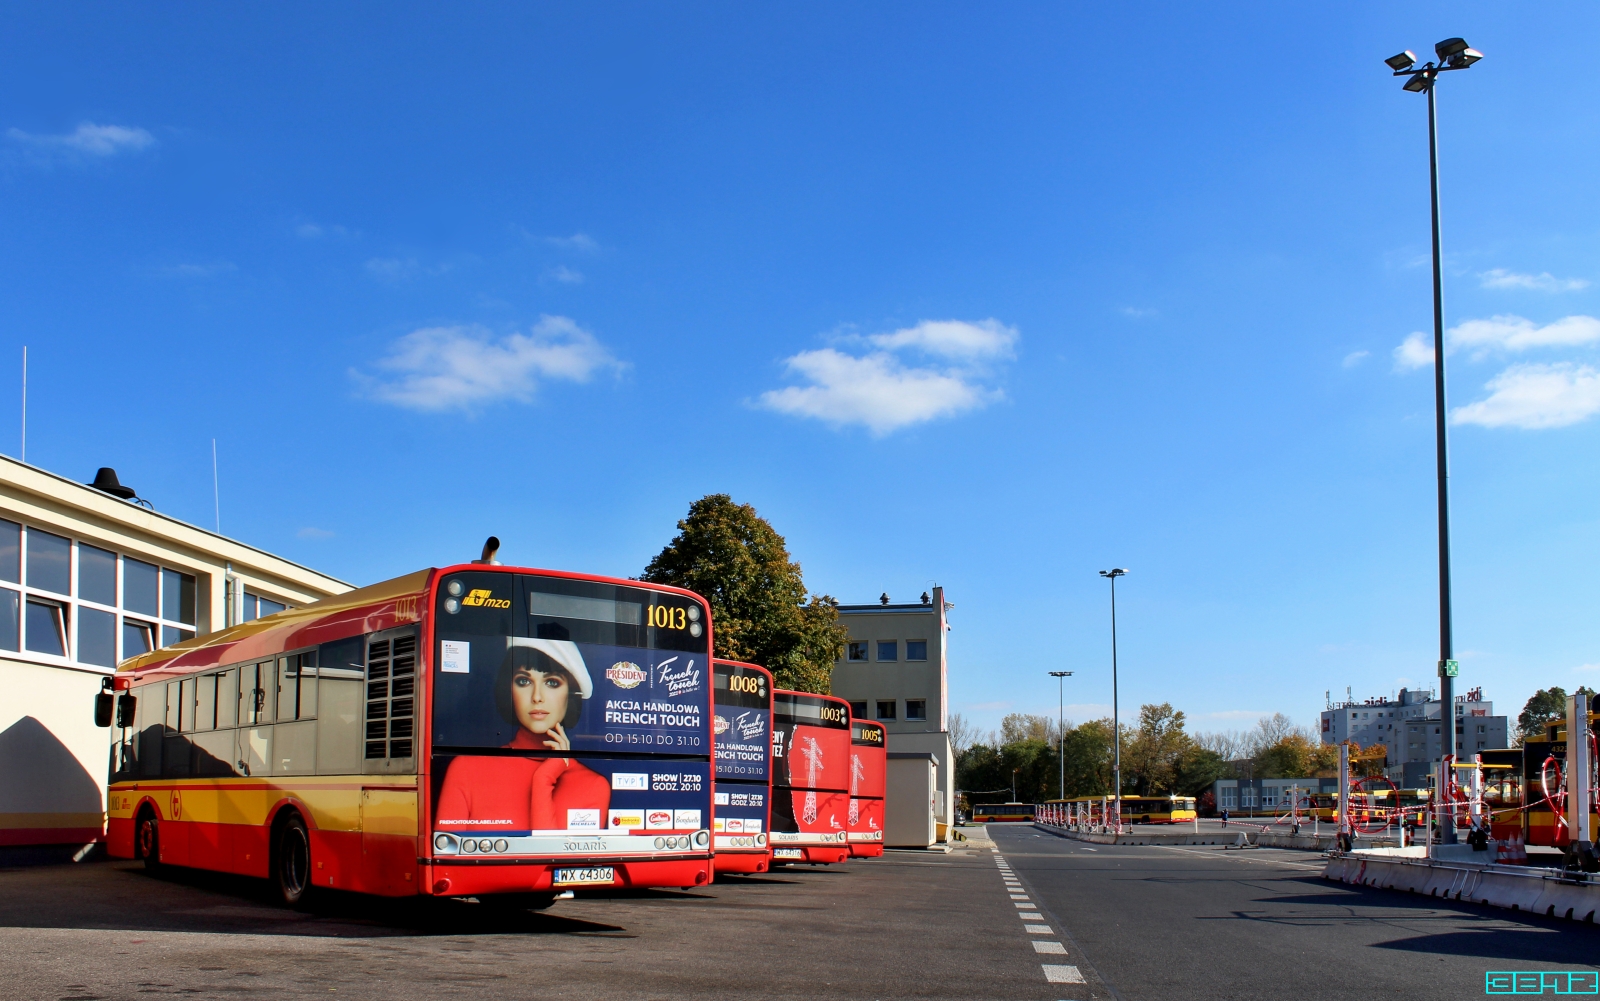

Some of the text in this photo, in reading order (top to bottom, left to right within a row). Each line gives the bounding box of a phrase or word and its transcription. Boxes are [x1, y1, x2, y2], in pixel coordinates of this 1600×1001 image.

[395, 596, 417, 622] 1013
[647, 604, 686, 630] 1013
[606, 668, 647, 681] PRÉSIDENT
[656, 655, 695, 684] French
[665, 669, 700, 692] touch
[729, 675, 758, 693] 1008
[606, 700, 700, 714] AKCJA HANDLOWA
[605, 711, 700, 727] FRENCH TOUCH
[820, 707, 840, 722] 1003
[605, 733, 700, 747] OD 15.10 DO 31.10
[861, 729, 878, 741] 1005
[726, 744, 764, 752] HANDLOWA
[737, 752, 764, 761] TOUCH
[735, 766, 746, 774] DO
[748, 767, 764, 775] 31.10
[617, 776, 644, 787] TVP 1
[652, 774, 701, 783] SHOW 27.10
[652, 782, 701, 791] GODZ. 20:10
[563, 842, 607, 851] SOLARIS
[560, 868, 612, 881] WX 64306
